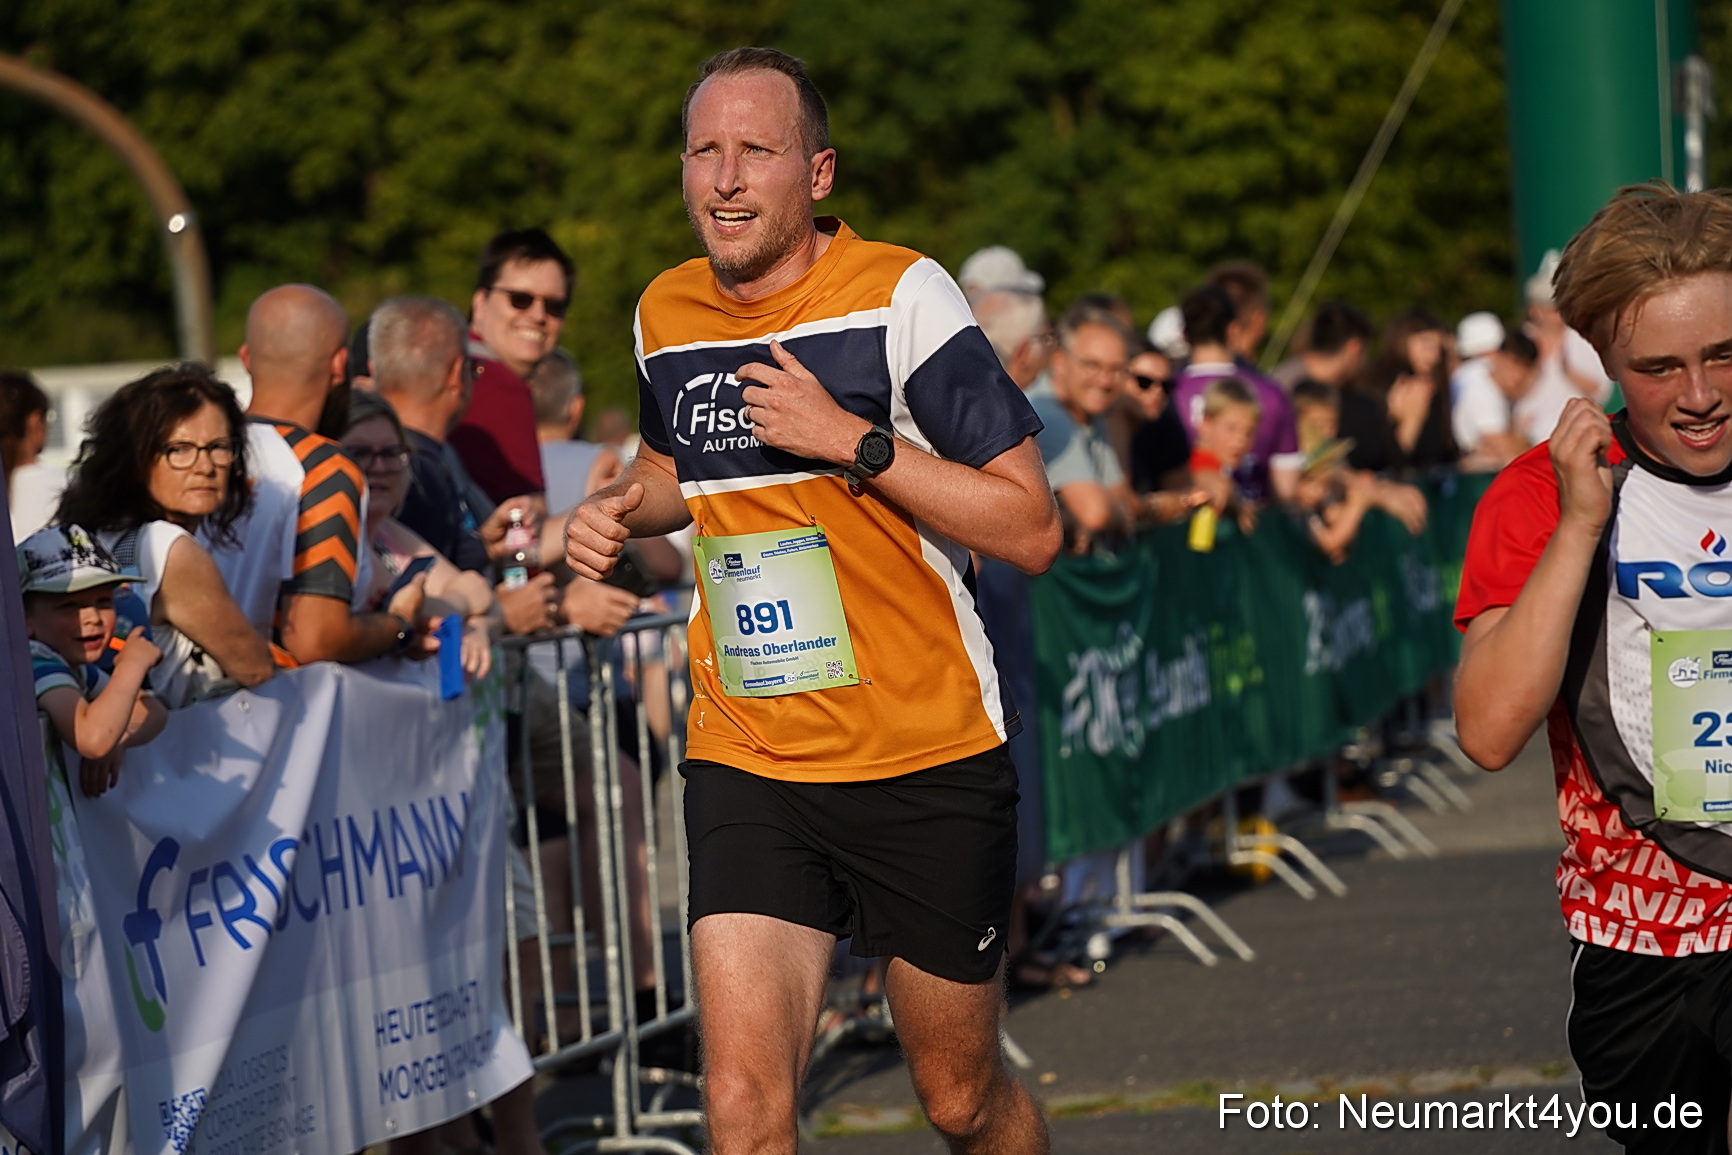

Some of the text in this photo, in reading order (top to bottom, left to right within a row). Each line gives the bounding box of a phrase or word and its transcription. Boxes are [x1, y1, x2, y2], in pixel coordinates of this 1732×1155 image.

[690, 402, 757, 435] Fisc
[702, 437, 770, 453] AUTOM
[723, 565, 761, 578] Firmenlauf
[736, 574, 761, 583] neumarkt
[736, 599, 794, 636] 891
[724, 635, 837, 658] Andreas Oberlander
[185, 791, 470, 968] FRISCHMANN
[374, 999, 437, 1048] HEUTE
